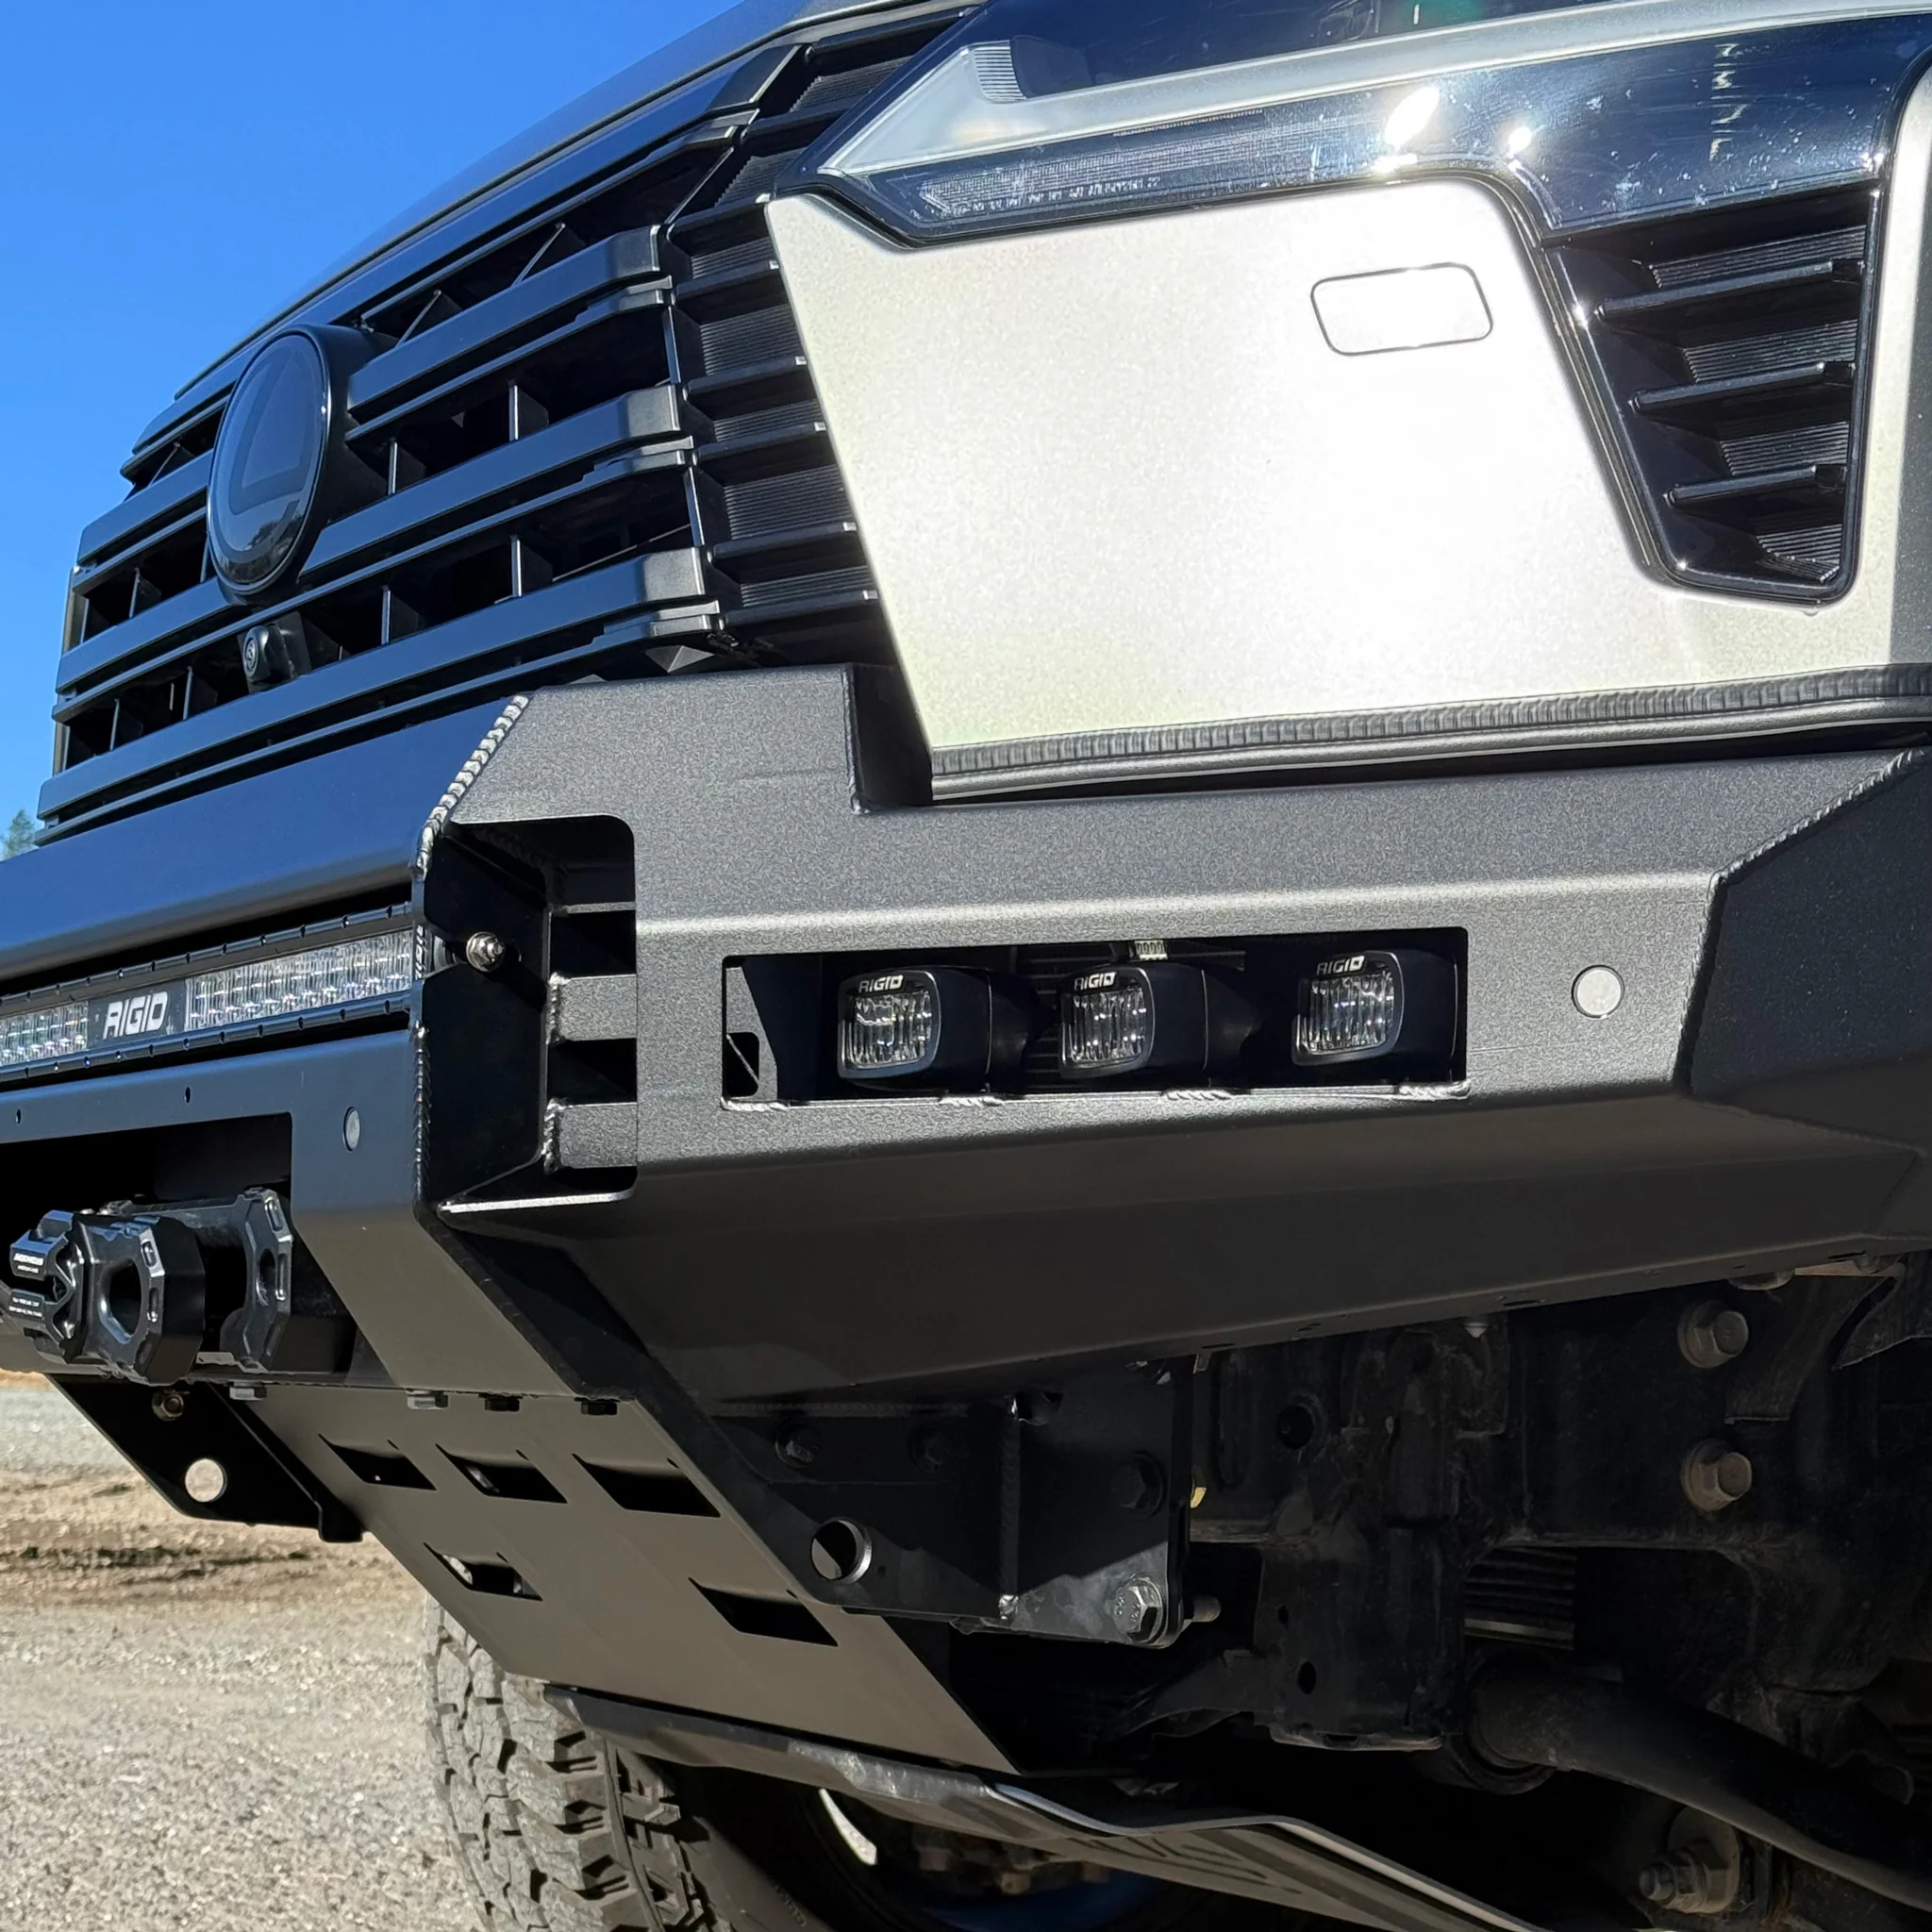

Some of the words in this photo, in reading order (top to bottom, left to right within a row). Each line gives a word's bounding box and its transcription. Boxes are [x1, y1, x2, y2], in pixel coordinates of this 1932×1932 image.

[1316, 955, 1365, 976] RIGID
[858, 974, 904, 993] RIGID
[1074, 972, 1117, 991] RIGID
[103, 991, 168, 1040] RIGID
